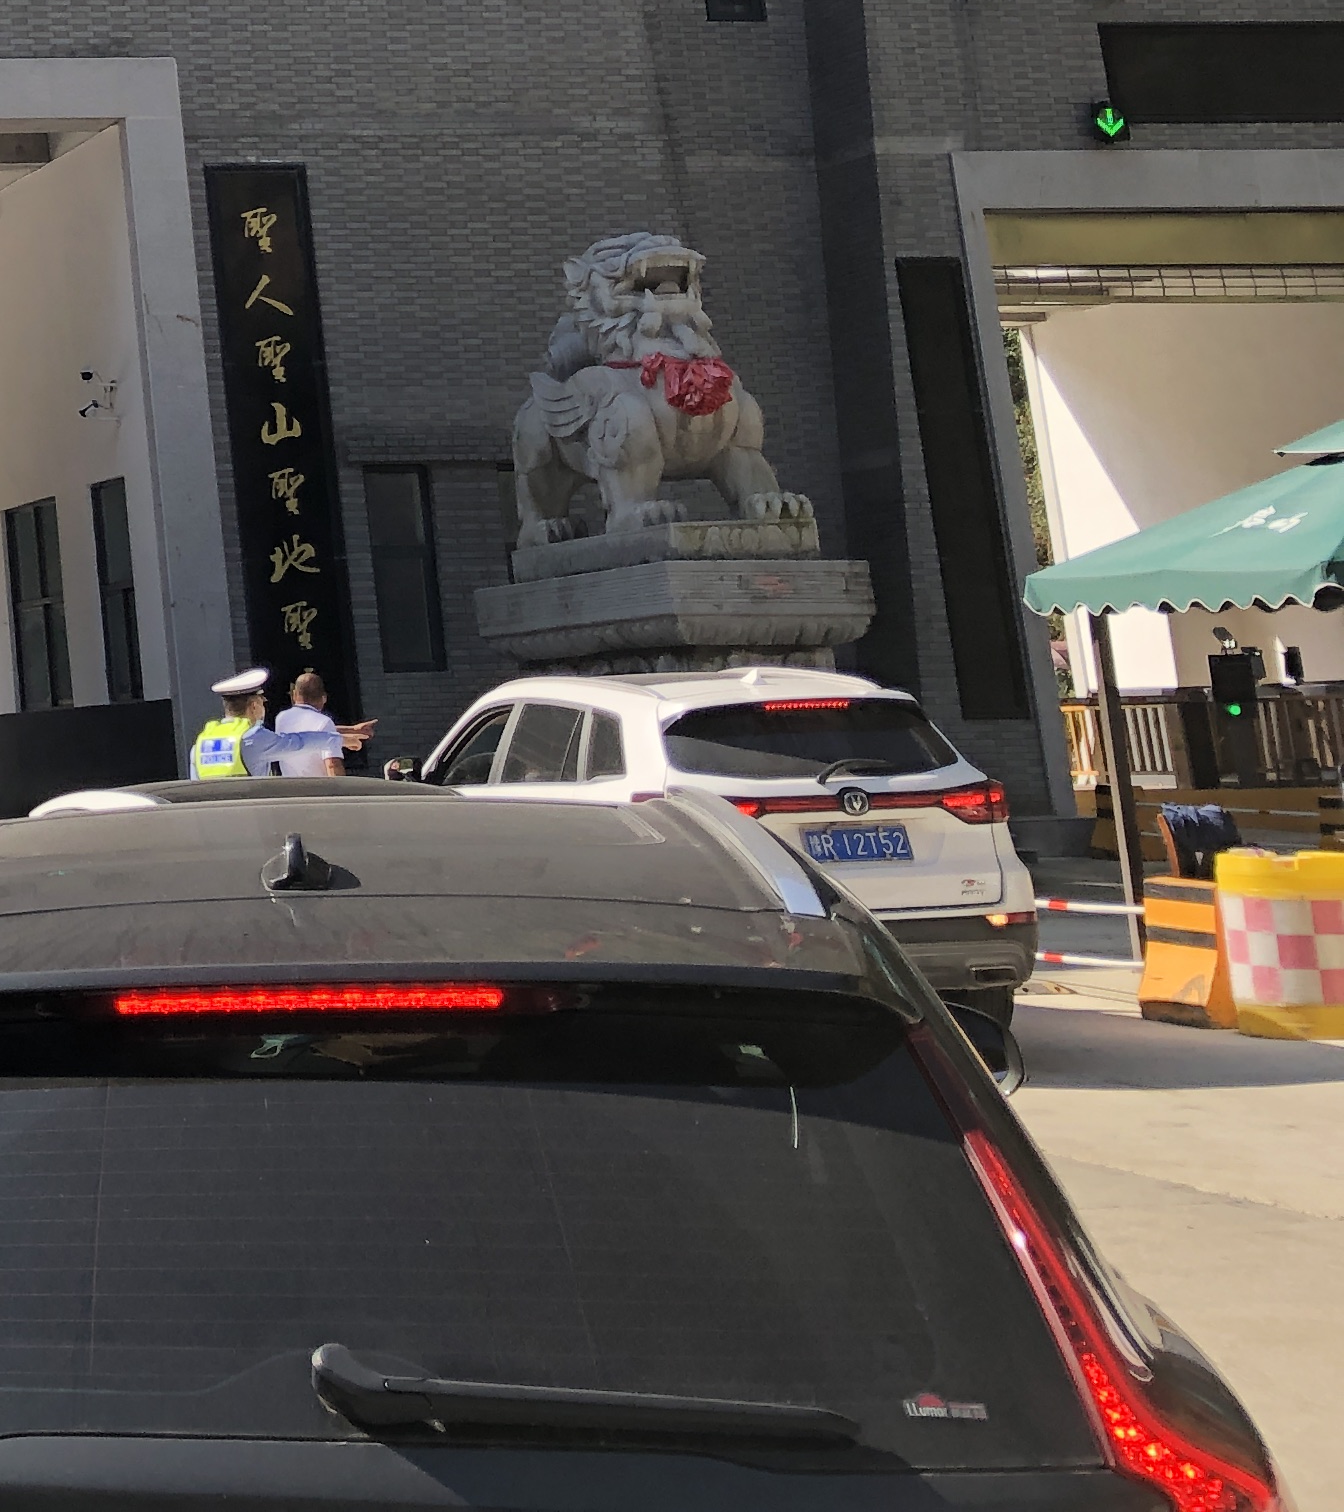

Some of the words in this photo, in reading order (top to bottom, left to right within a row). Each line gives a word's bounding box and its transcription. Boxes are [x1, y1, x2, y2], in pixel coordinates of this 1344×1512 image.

[241, 207, 321, 700] 聖人聖山聖地聖
